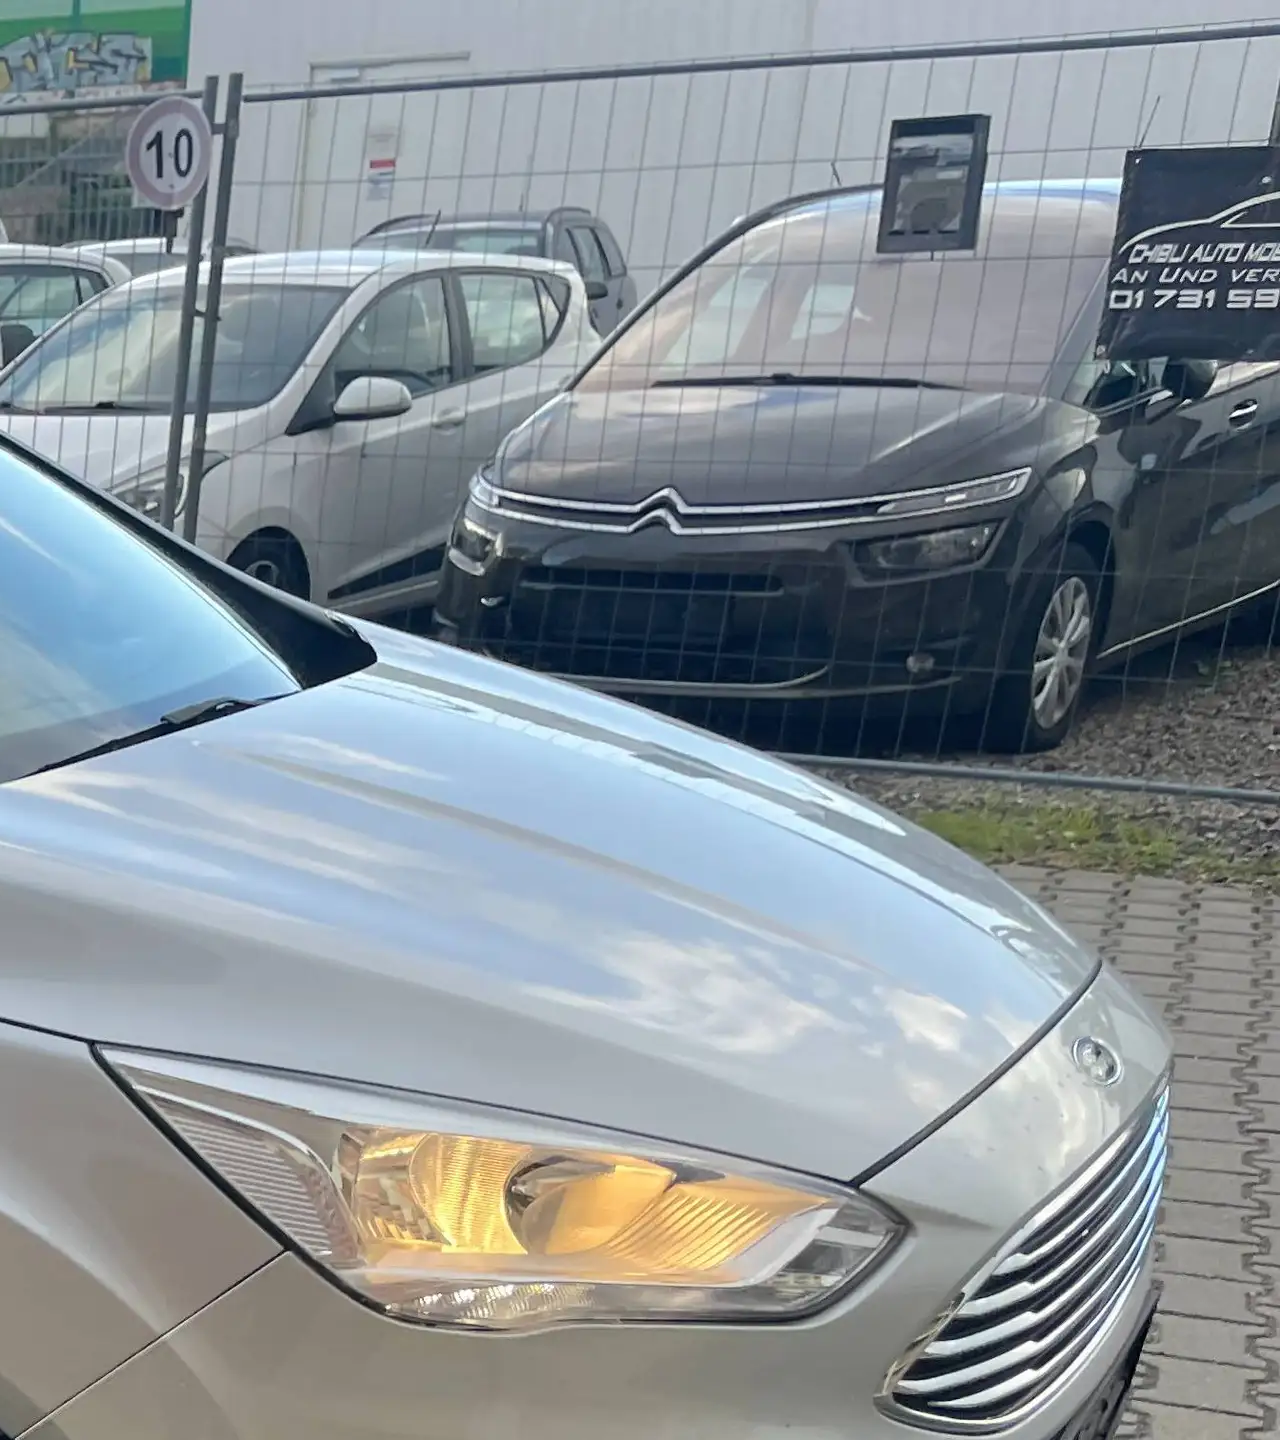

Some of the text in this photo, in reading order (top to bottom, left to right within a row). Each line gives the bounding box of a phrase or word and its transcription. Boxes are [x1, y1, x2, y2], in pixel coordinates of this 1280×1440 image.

[146, 128, 193, 179] 10
[1188, 243, 1246, 263] AUTO
[1111, 267, 1280, 284] AN UND VER
